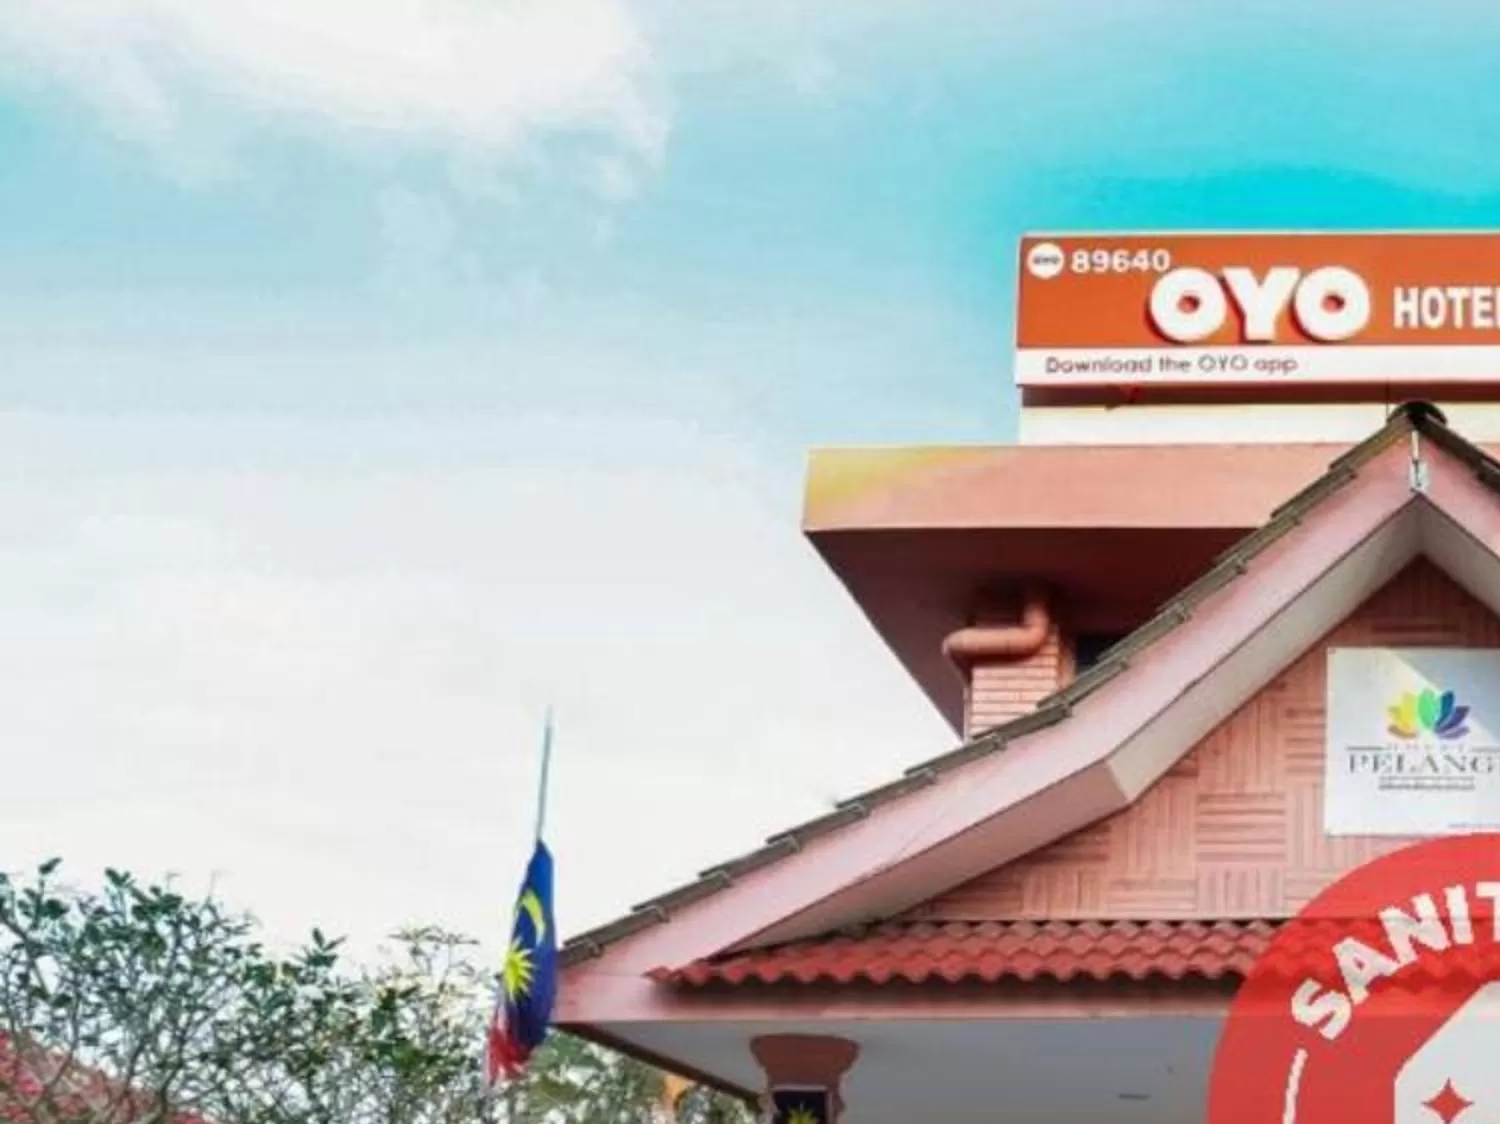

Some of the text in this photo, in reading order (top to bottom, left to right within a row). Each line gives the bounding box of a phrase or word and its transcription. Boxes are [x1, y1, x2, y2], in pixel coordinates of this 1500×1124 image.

[1072, 248, 1170, 273] 89640
[1149, 266, 1371, 343] OYO
[1045, 353, 1299, 375] Download the OYO app
